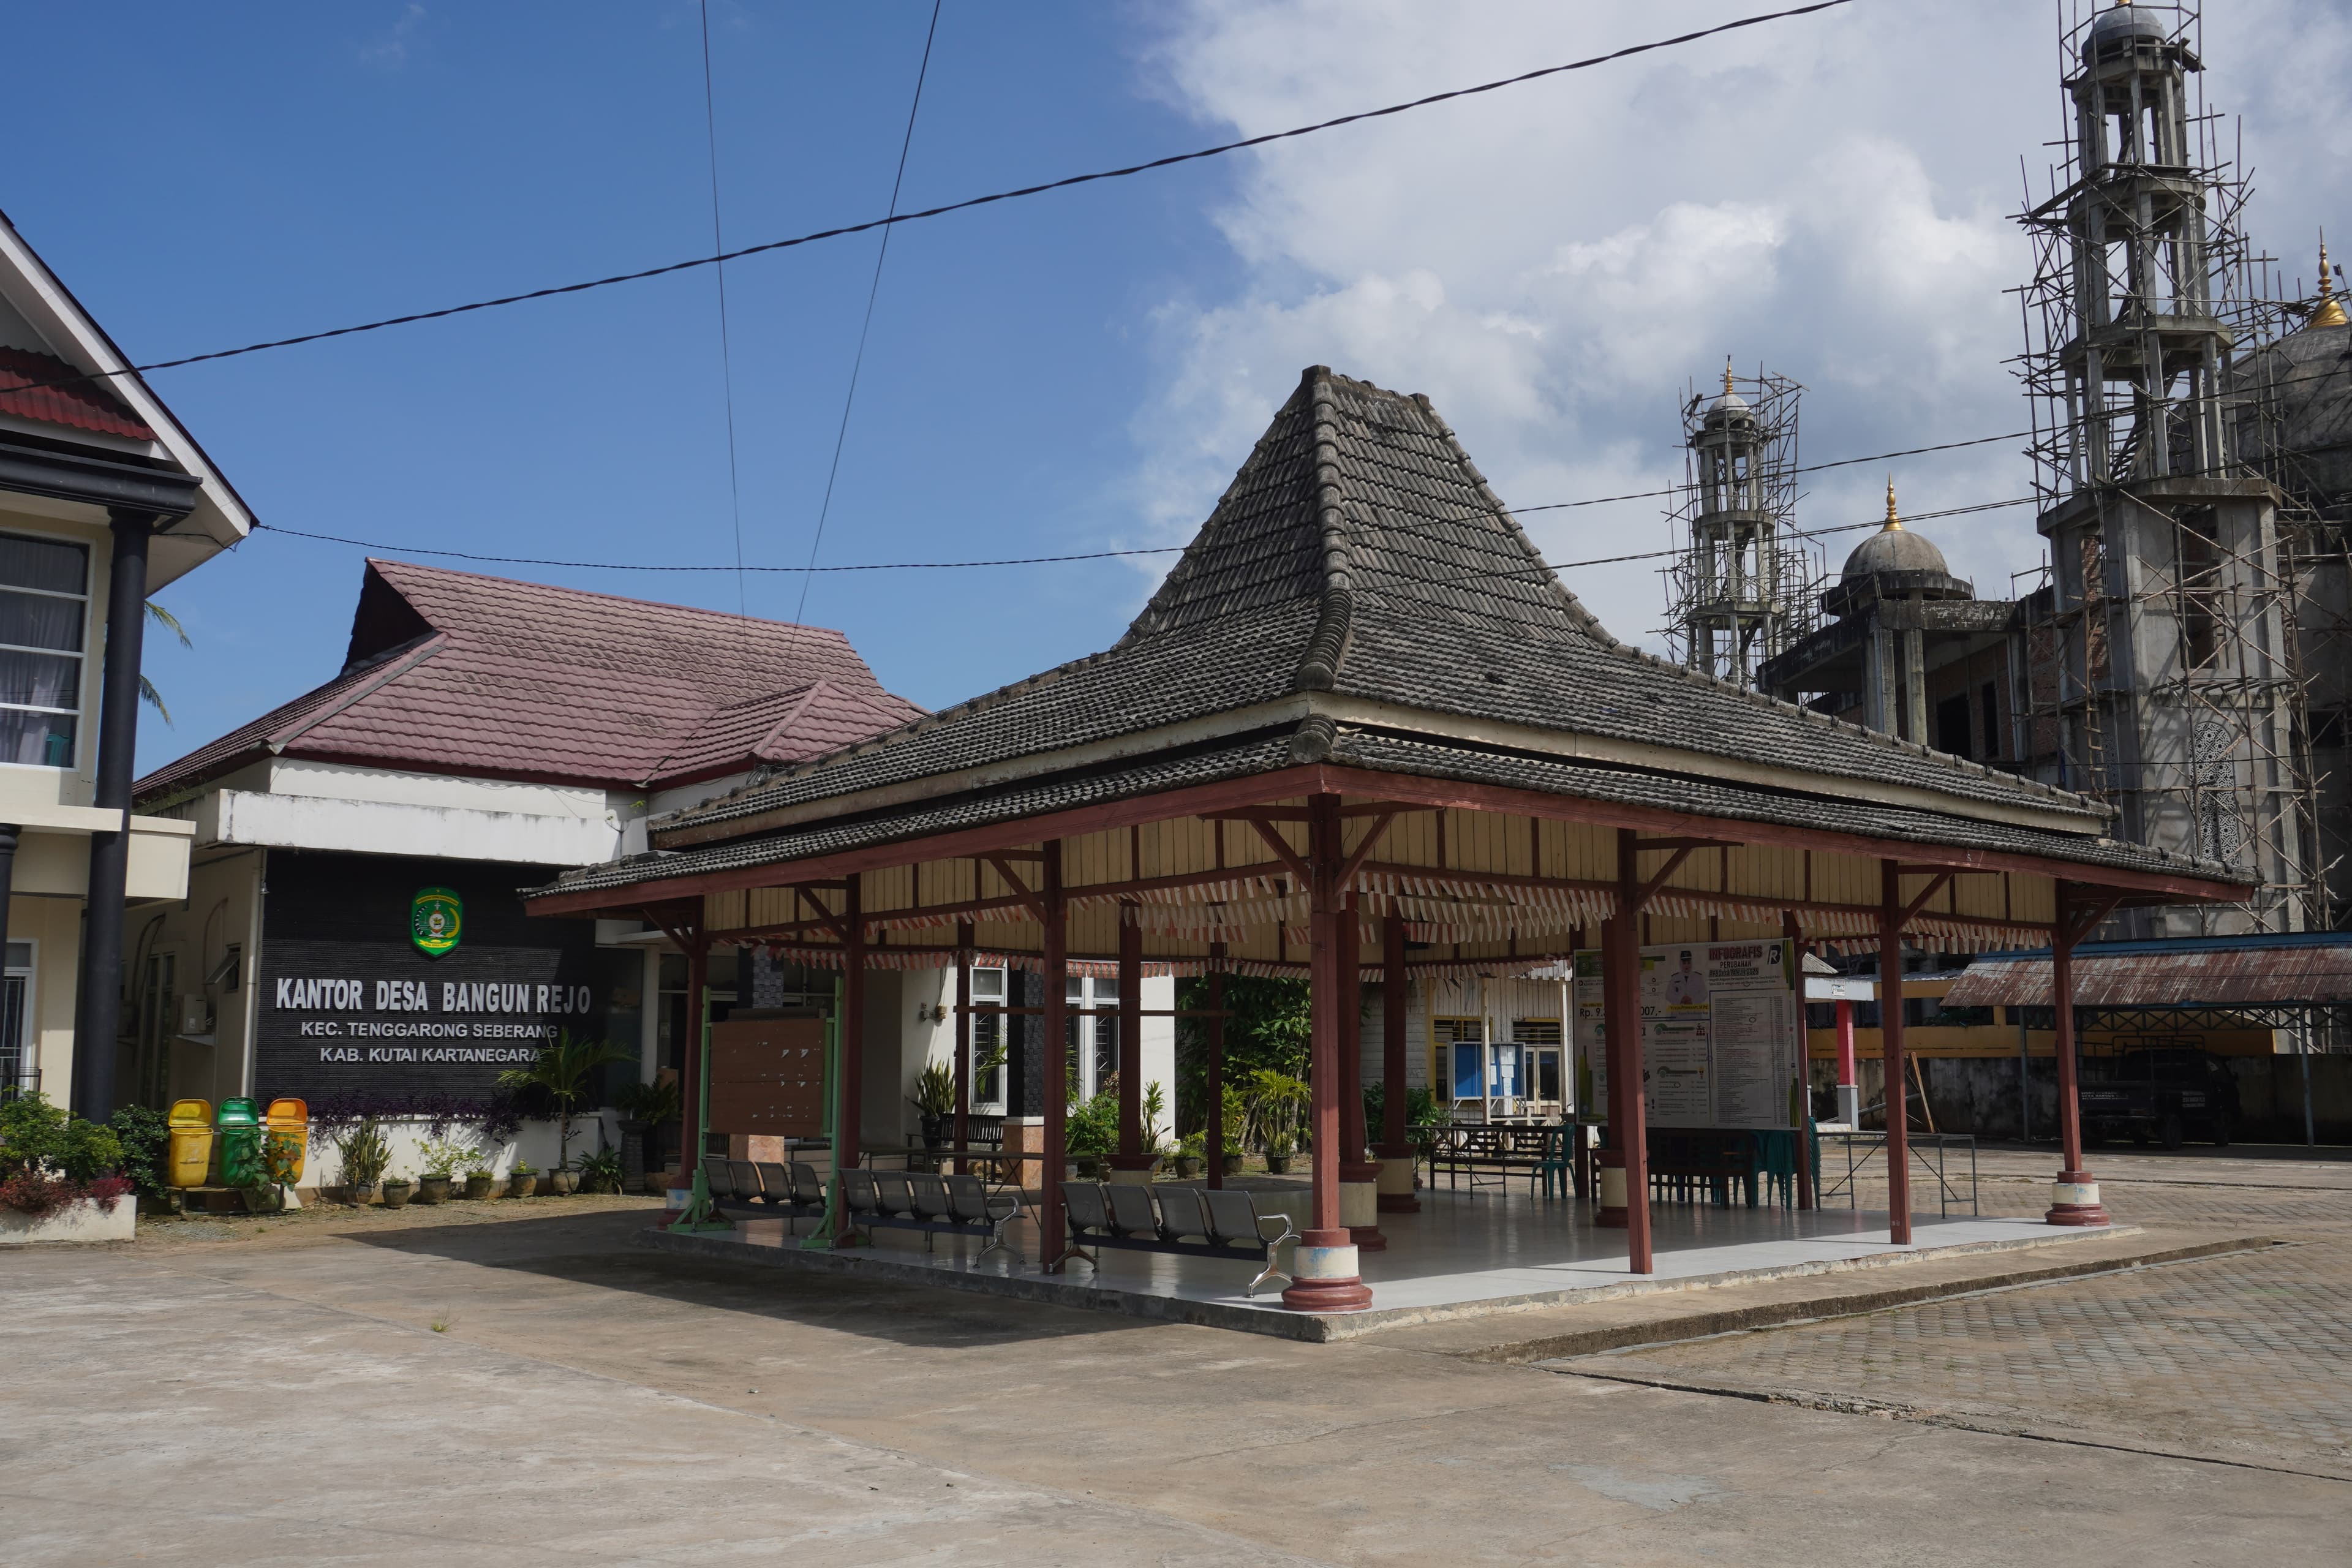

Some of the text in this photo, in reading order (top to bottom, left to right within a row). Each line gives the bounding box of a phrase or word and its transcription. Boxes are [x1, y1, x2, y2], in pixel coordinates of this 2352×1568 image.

[1709, 945, 1763, 960] INFOGRAFIS
[276, 978, 590, 1014] KANTOR DESA BANGUN REJO
[1580, 1008, 1605, 1019] Rp. 9.
[301, 1022, 557, 1038] KEC. TENGGARONG SEBERANG
[320, 1048, 541, 1061] KAB. KUTAI KARTANEGARA
